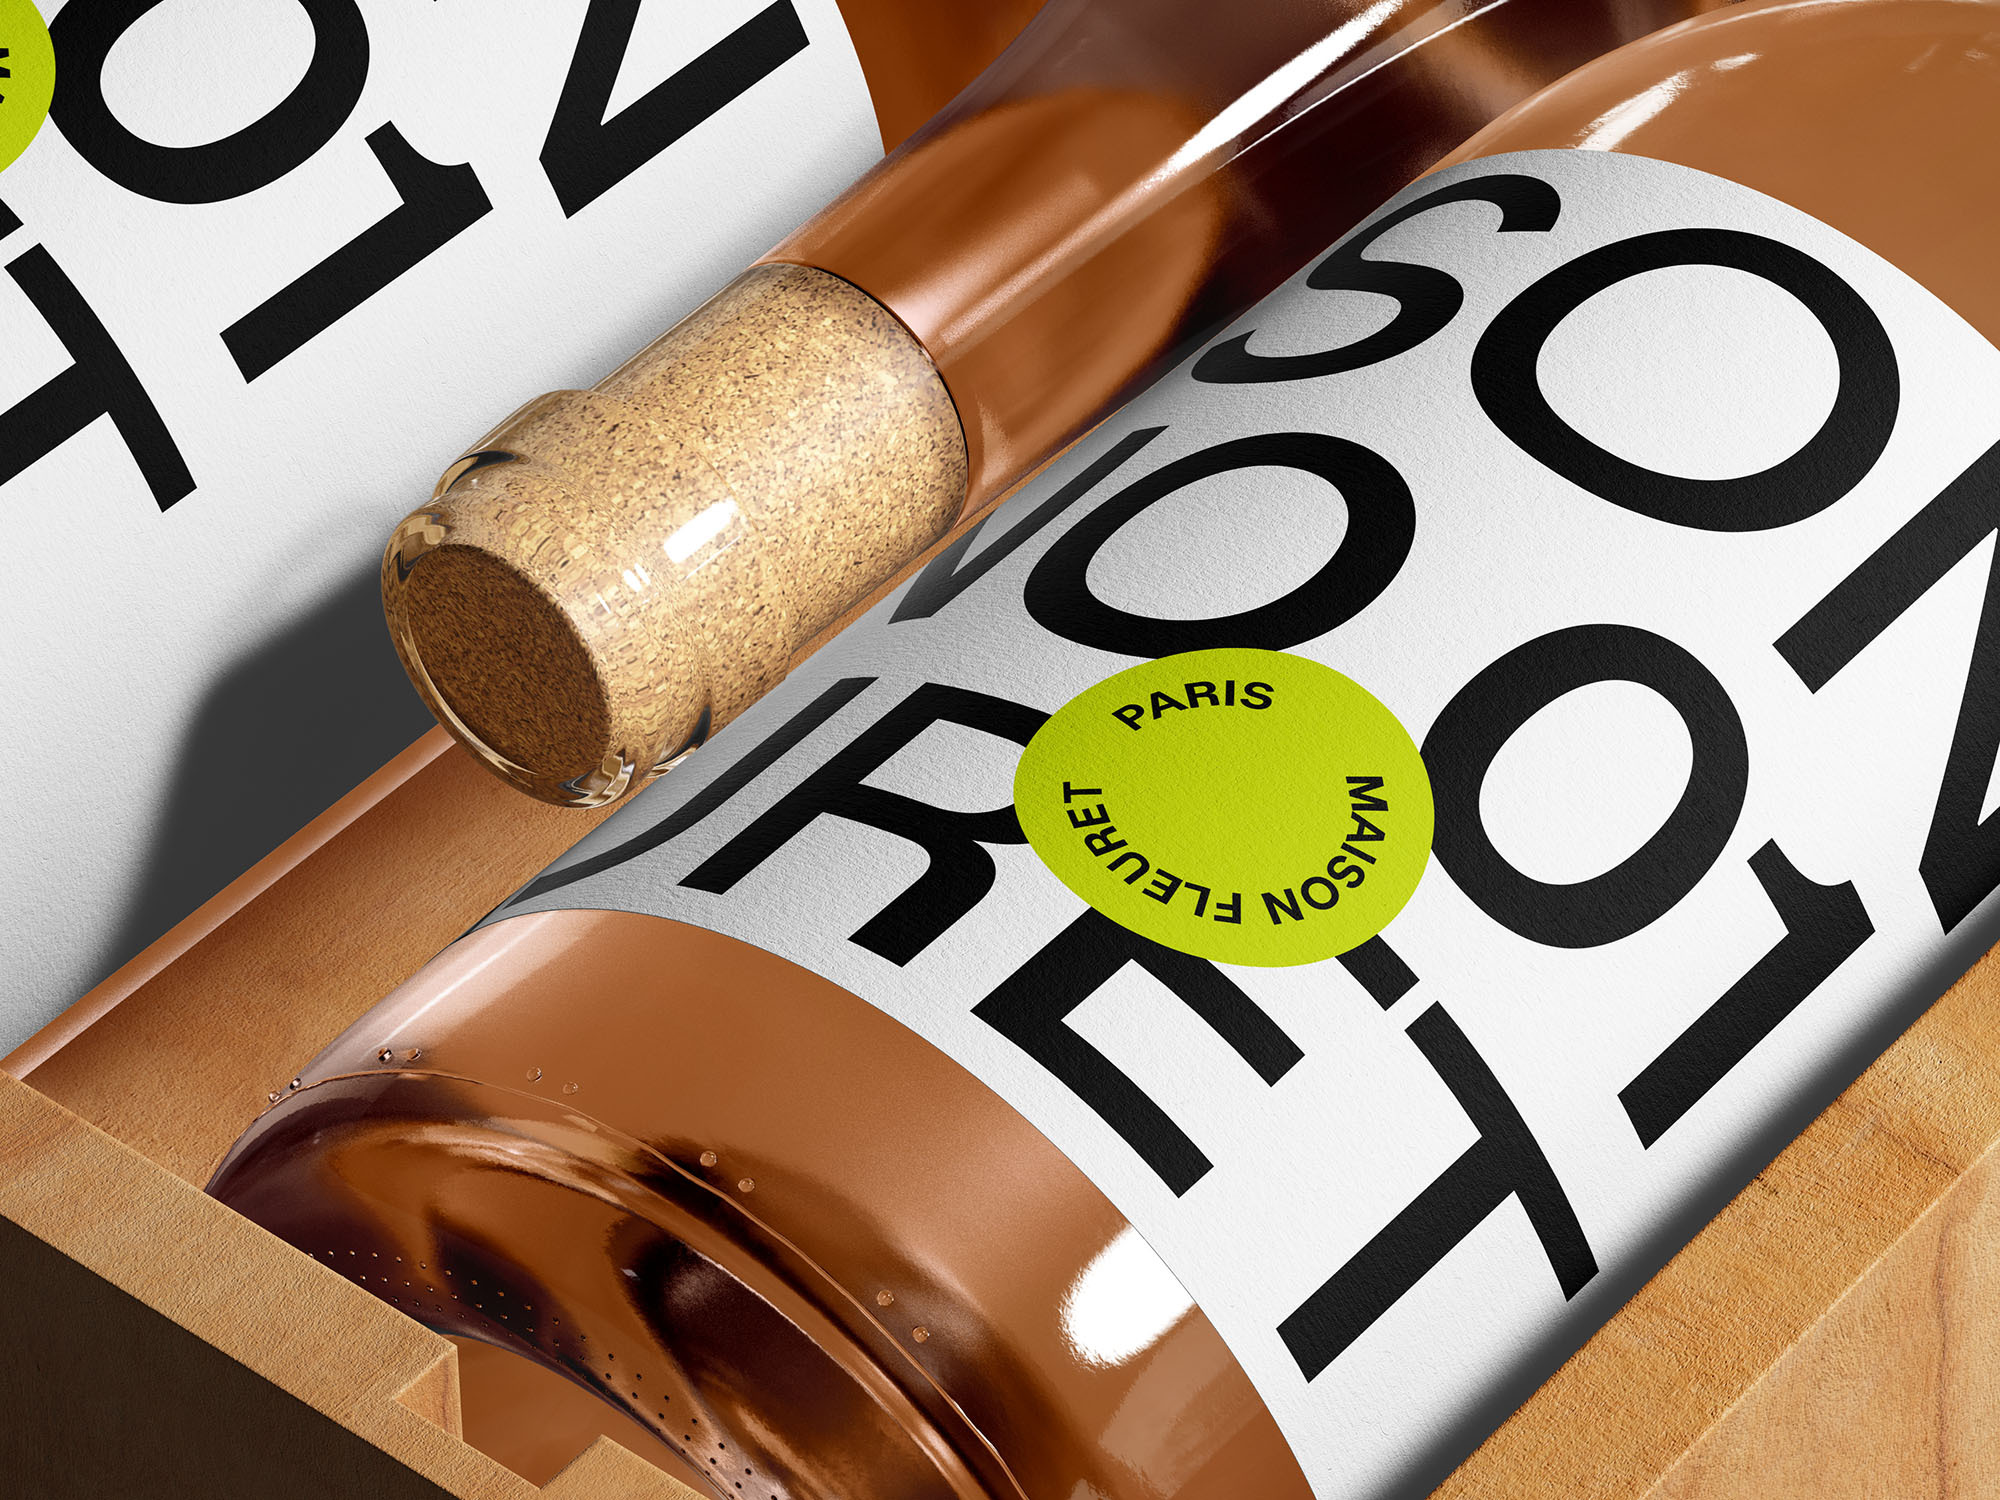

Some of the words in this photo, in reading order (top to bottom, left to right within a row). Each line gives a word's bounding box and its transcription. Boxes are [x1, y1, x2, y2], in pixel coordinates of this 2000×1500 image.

[1112, 680, 1275, 732] PARIS
[1063, 781, 1242, 925] FLEURET
[1261, 776, 1389, 926] MAISON
